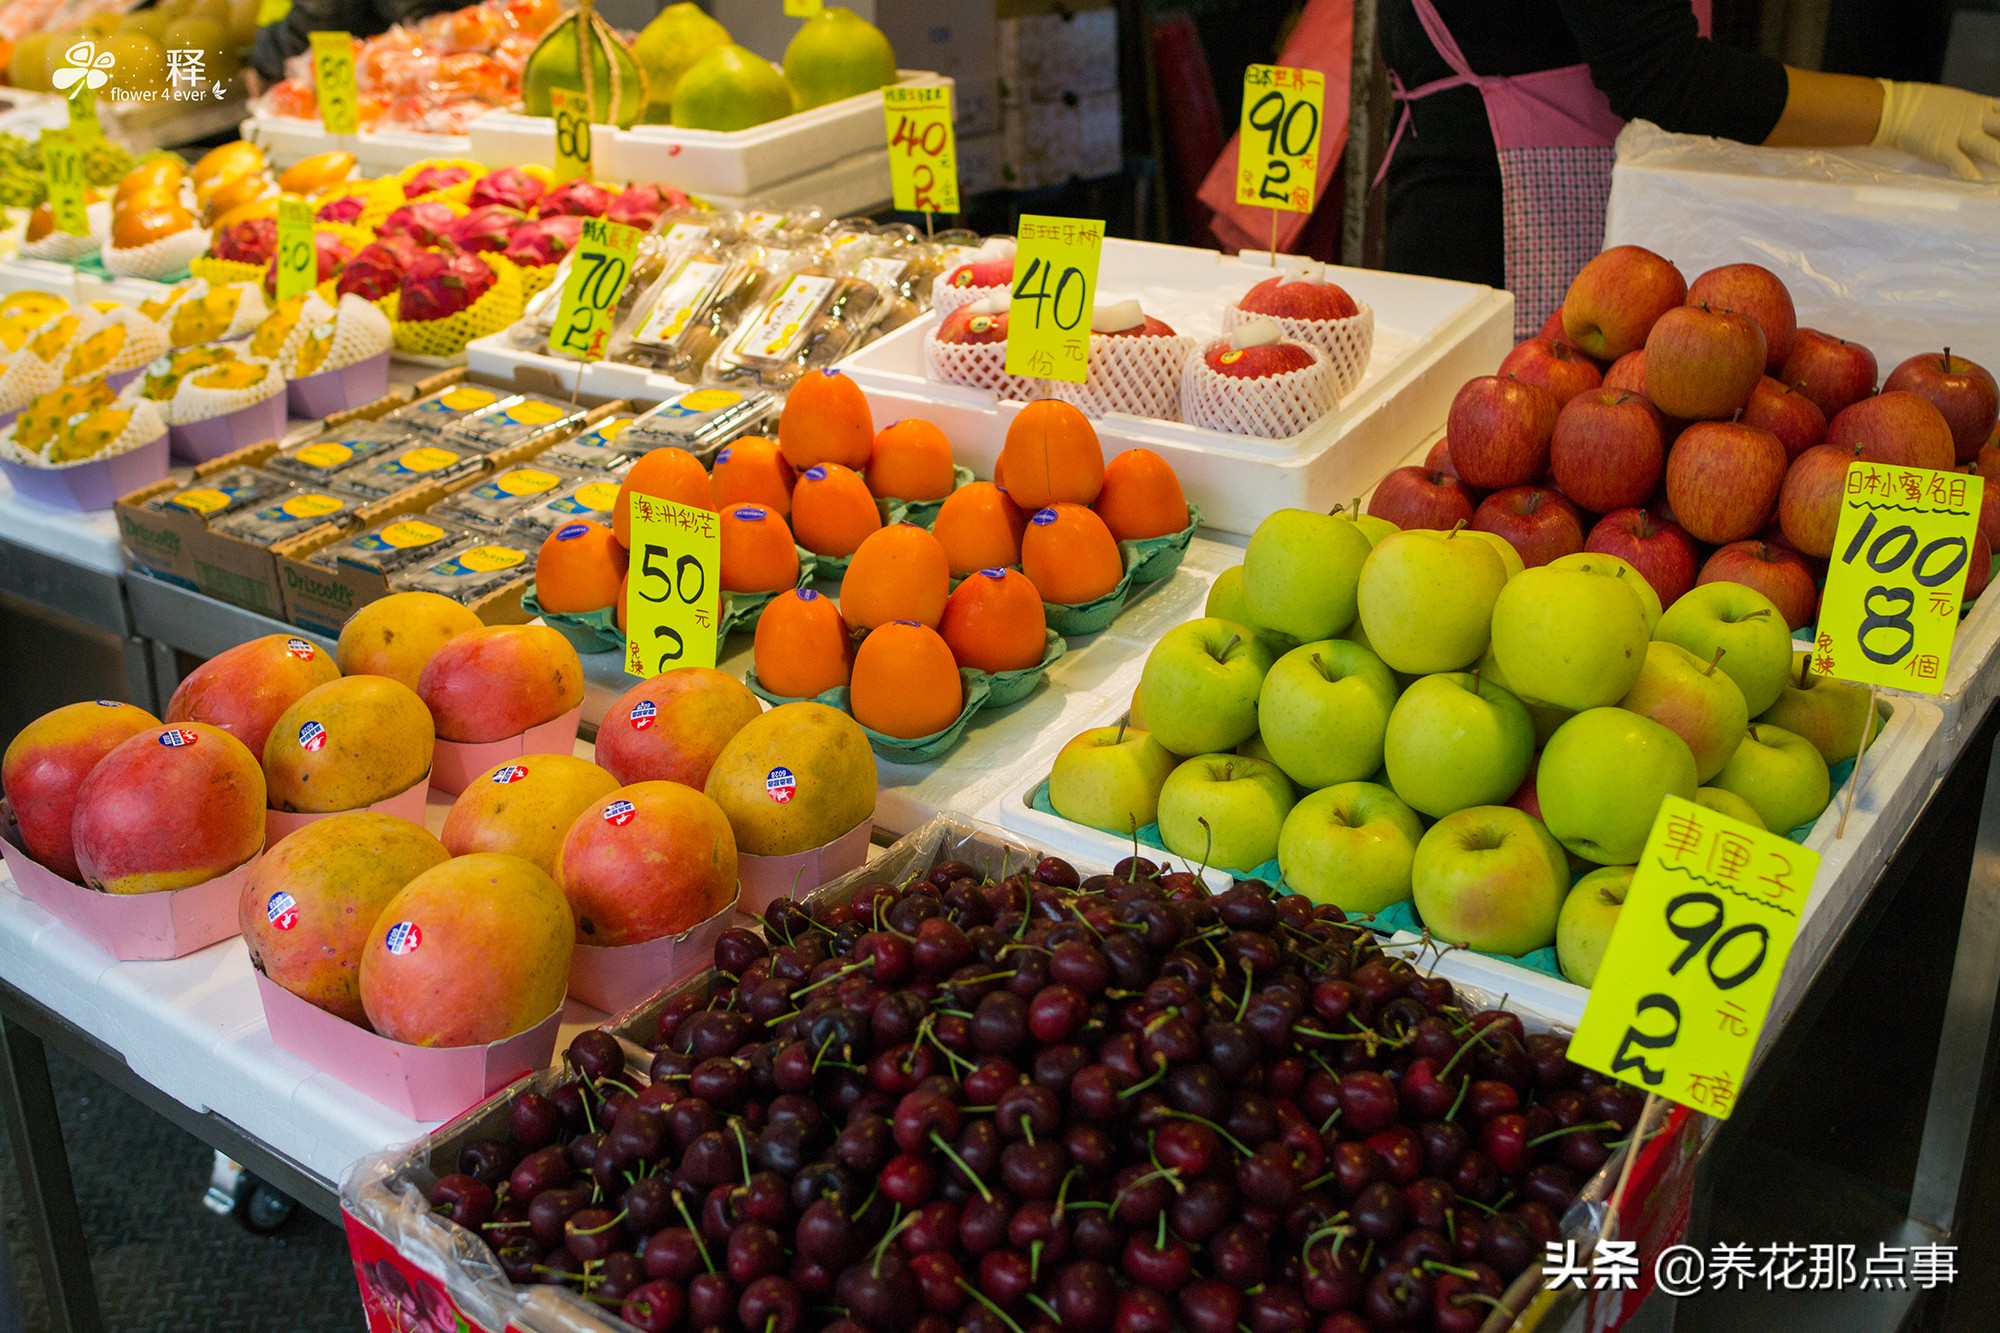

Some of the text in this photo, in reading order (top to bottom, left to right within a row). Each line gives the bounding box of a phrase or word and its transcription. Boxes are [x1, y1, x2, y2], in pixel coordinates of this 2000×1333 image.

[557, 112, 591, 163] 60
[892, 116, 947, 156] 40
[1249, 91, 1319, 157] 90
[913, 165, 942, 212] 2
[1259, 160, 1290, 203] 2
[578, 252, 625, 310] 70
[1013, 257, 1086, 330] 40
[561, 306, 593, 351] 2
[1063, 339, 1084, 361] 元
[1027, 349, 1055, 376] 份
[1842, 511, 1968, 587] 100
[638, 544, 705, 604] 50
[695, 609, 710, 629] 元
[1857, 585, 1914, 665] 8
[1929, 591, 1953, 617] 元
[1904, 654, 1940, 679] 個
[1663, 812, 1795, 900] 車厘子
[1665, 892, 1770, 991] 90
[1611, 993, 1682, 1086] 2
[1715, 1000, 1750, 1038] 元
[1682, 1071, 1736, 1116] 磅
